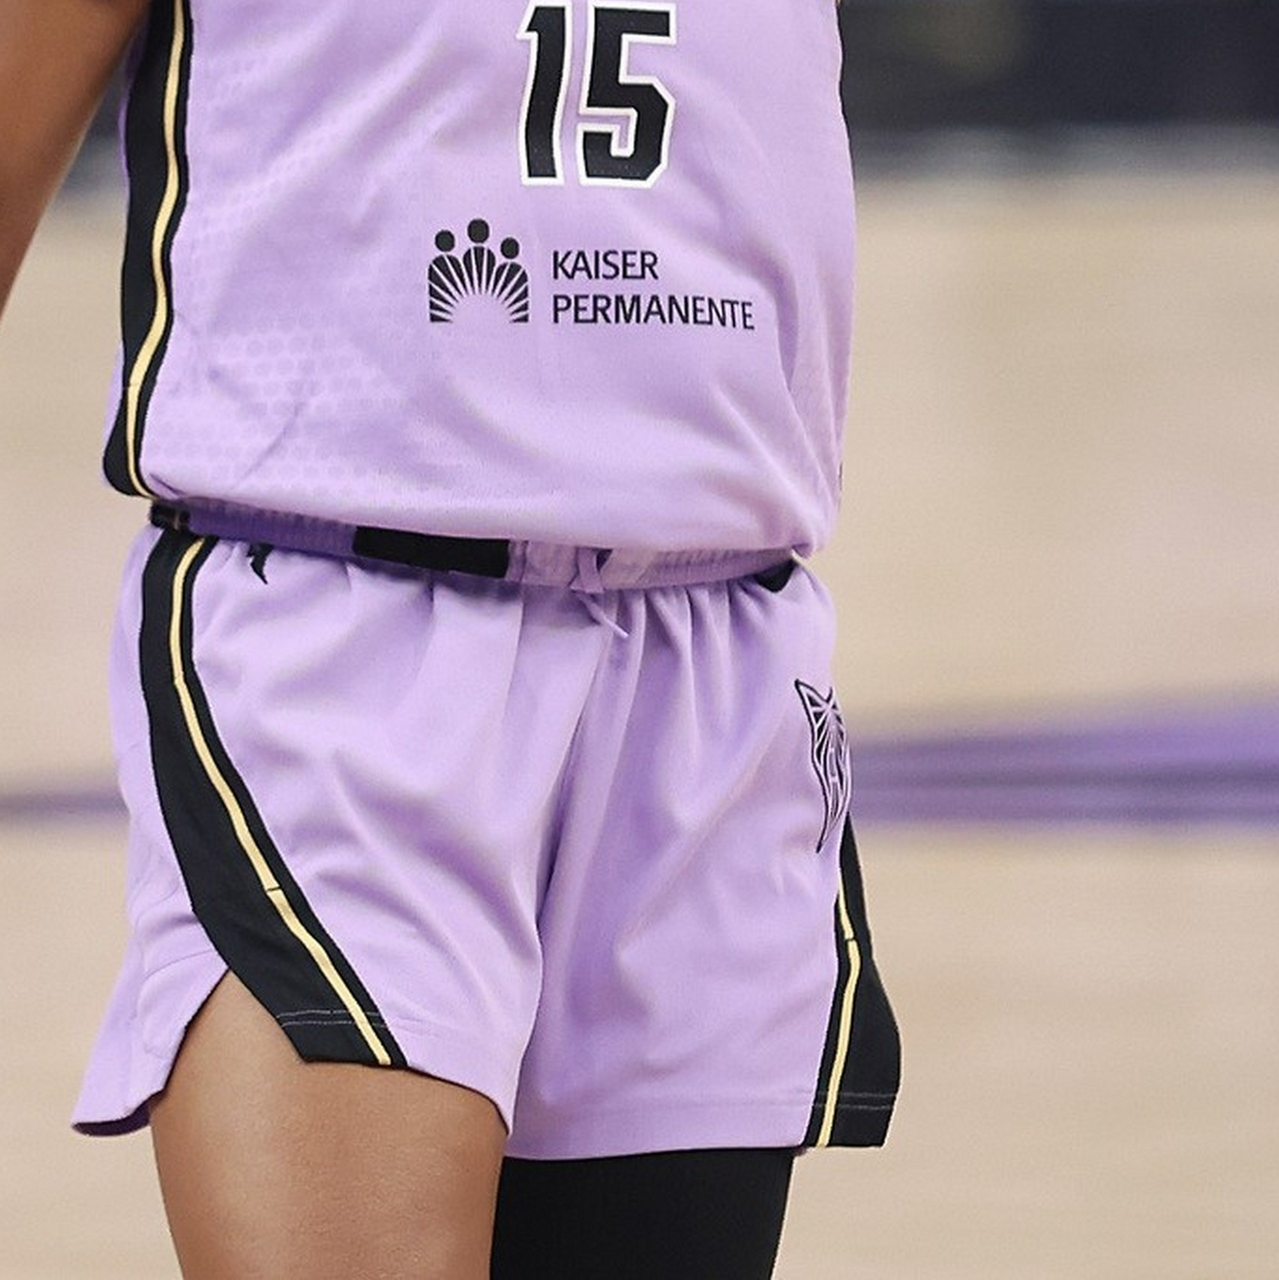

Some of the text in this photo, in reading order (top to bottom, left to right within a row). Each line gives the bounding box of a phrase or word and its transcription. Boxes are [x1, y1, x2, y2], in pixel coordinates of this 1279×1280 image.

[518, 0, 676, 186] 15
[552, 249, 660, 281] KAISER
[552, 294, 756, 331] PERMANENTE
